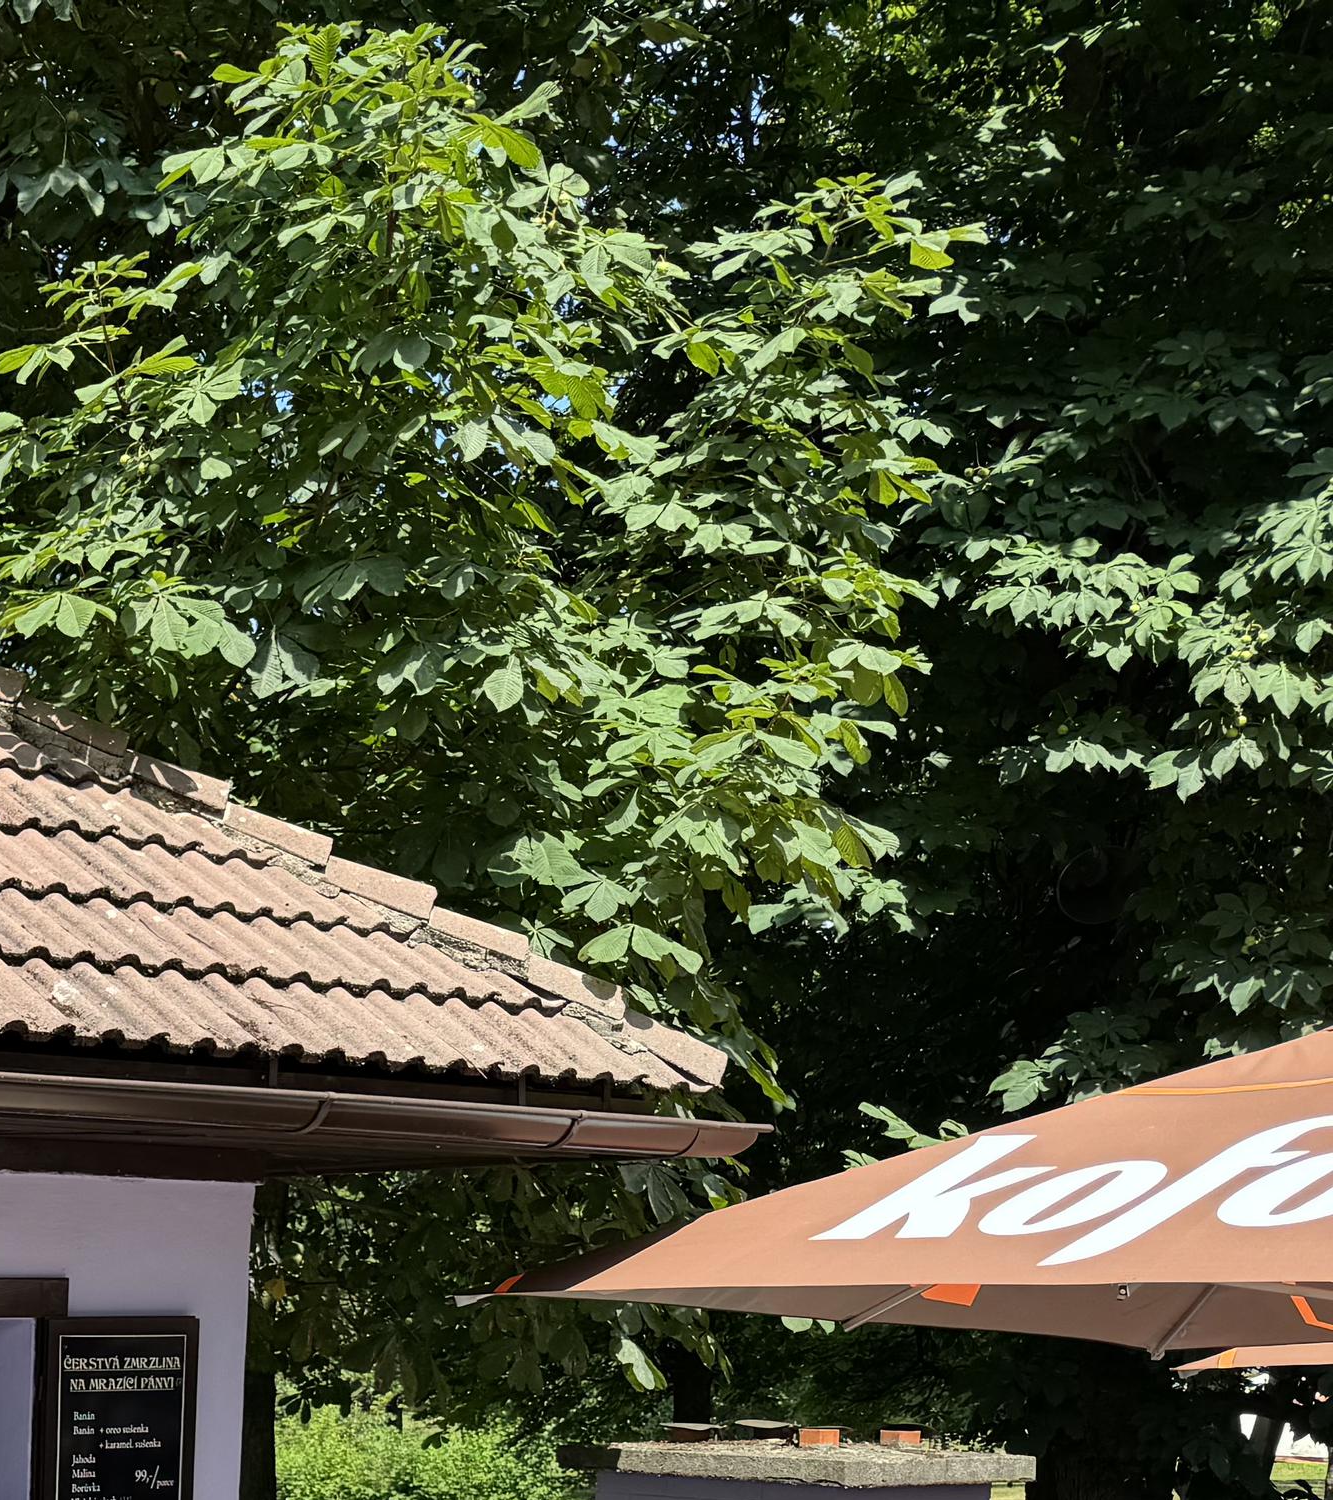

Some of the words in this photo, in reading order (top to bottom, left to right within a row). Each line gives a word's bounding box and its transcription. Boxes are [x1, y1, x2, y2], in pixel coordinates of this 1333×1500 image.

[63, 1355, 120, 1370] ČERSTVÁ
[124, 1356, 181, 1369] ZMRZLINA
[70, 1379, 86, 1390] NA
[89, 1376, 137, 1390] MRAZÍCÍ
[141, 1375, 174, 1389] PÁNVI
[71, 1454, 96, 1467] Jahoda
[72, 1470, 96, 1478] Malina
